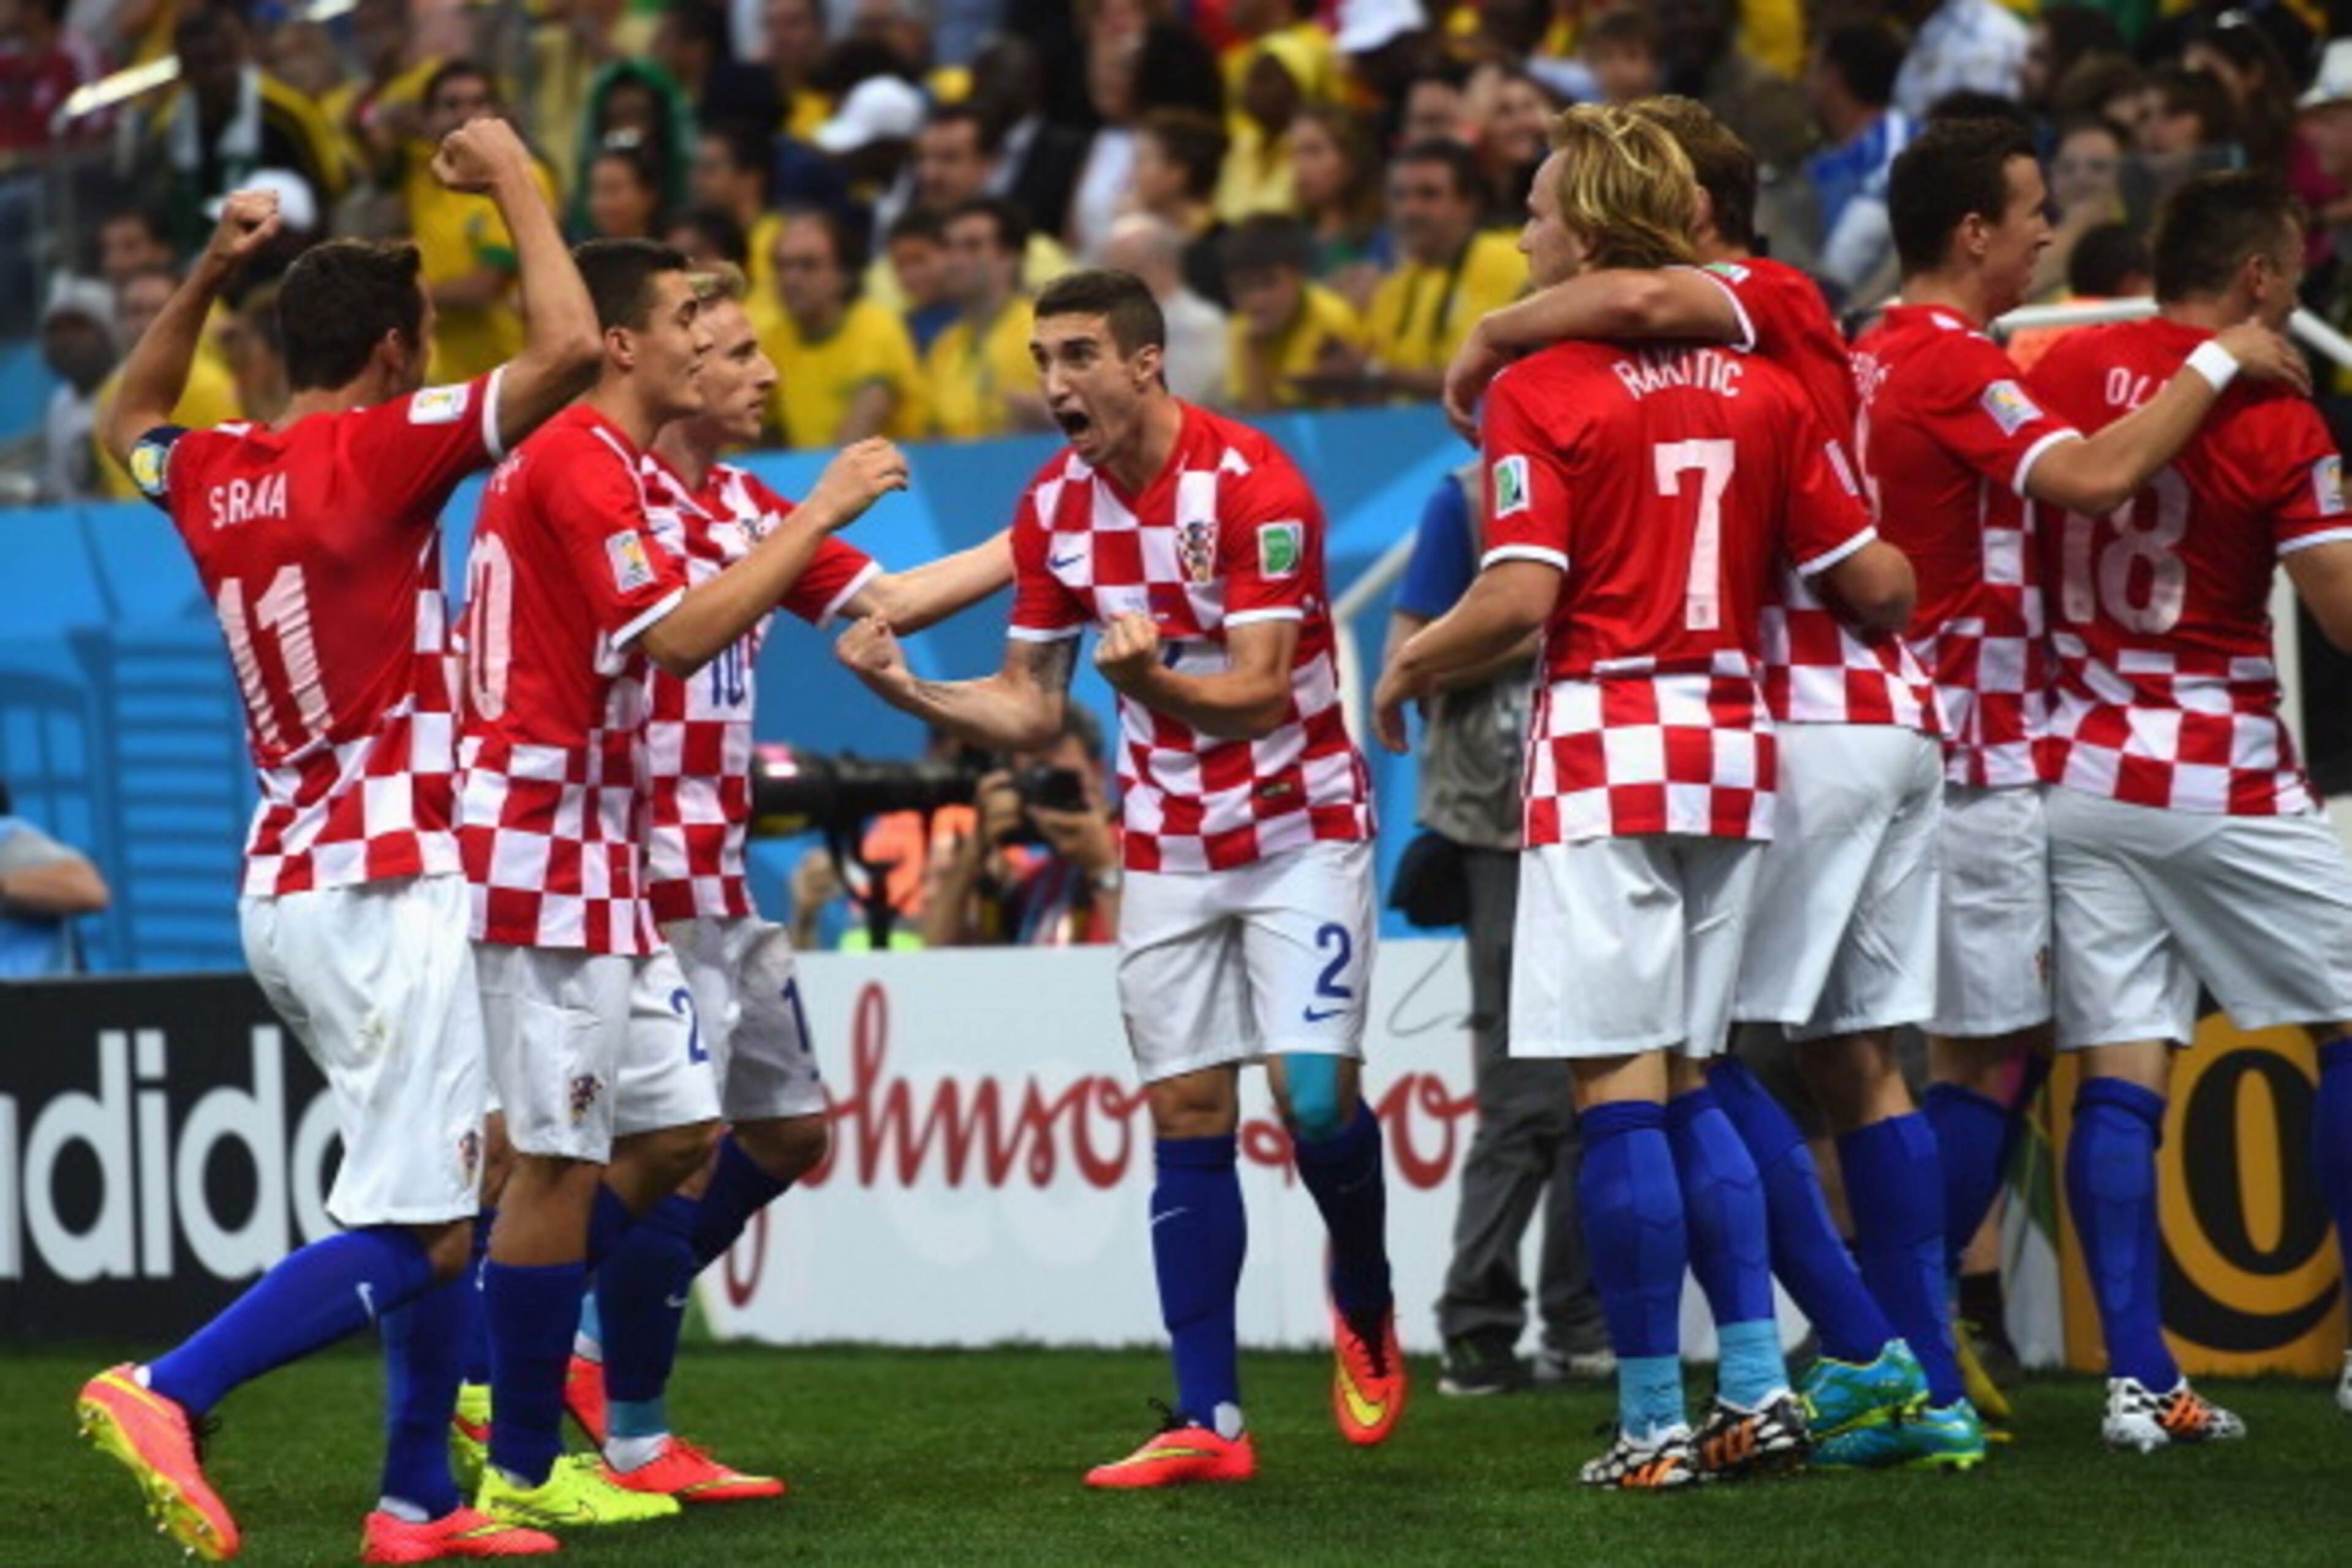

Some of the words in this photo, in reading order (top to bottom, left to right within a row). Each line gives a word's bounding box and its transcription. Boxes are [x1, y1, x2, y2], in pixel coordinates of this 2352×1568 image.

[2105, 366, 2168, 412] OL
[1654, 439, 1735, 631] 7
[2063, 462, 2191, 635] 18
[217, 564, 334, 753] 11
[466, 532, 513, 722] 0
[670, 989, 709, 1065] 2
[1316, 922, 1352, 999] 2
